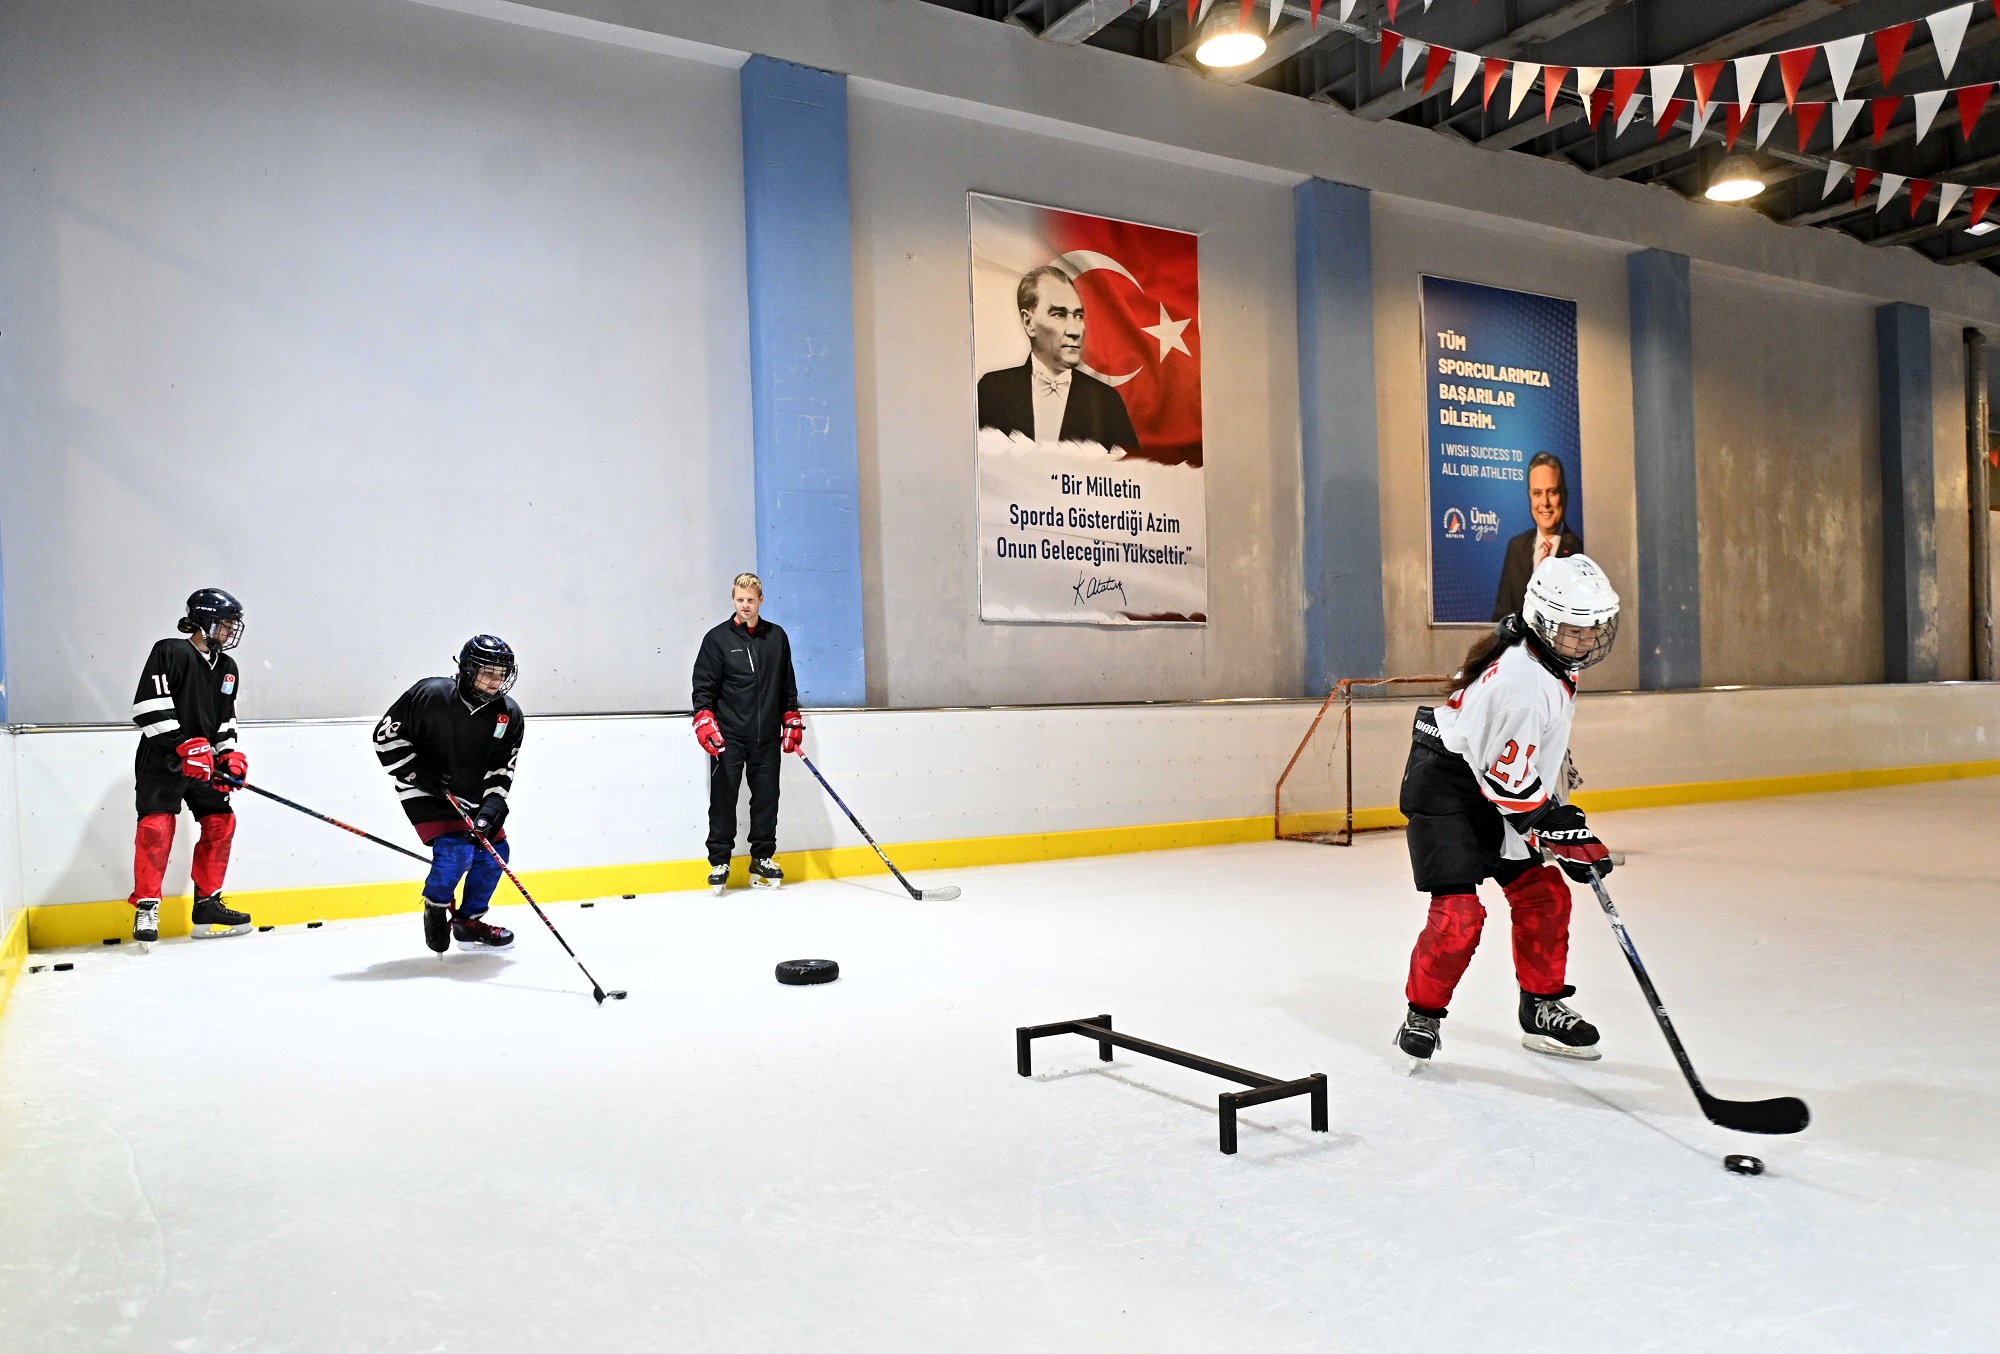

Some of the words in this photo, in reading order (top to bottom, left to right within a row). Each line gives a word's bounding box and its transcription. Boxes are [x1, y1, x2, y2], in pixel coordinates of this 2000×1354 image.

[1437, 329, 1467, 352] TÜM
[1438, 358, 1550, 388] SPORCULARIMIZA
[1439, 383, 1515, 408] BAŞARILAR
[1440, 406, 1496, 430] DİLERİM.
[1441, 443, 1445, 455] I
[1446, 443, 1470, 457] WISH
[1470, 445, 1510, 461] SUCCESS
[1511, 450, 1523, 462] TO
[1442, 462, 1459, 476] ALL
[1460, 464, 1479, 477] OUR
[1480, 466, 1524, 481] ATHLETES
[1086, 475, 1141, 499] Milletin
[1009, 503, 1064, 530] Sporda
[1068, 507, 1143, 536] Gösterdiği
[1146, 512, 1180, 534] Azim
[1470, 506, 1497, 525] Ümit
[997, 536, 1037, 559] Onun
[1041, 538, 1120, 566] Geleceğini
